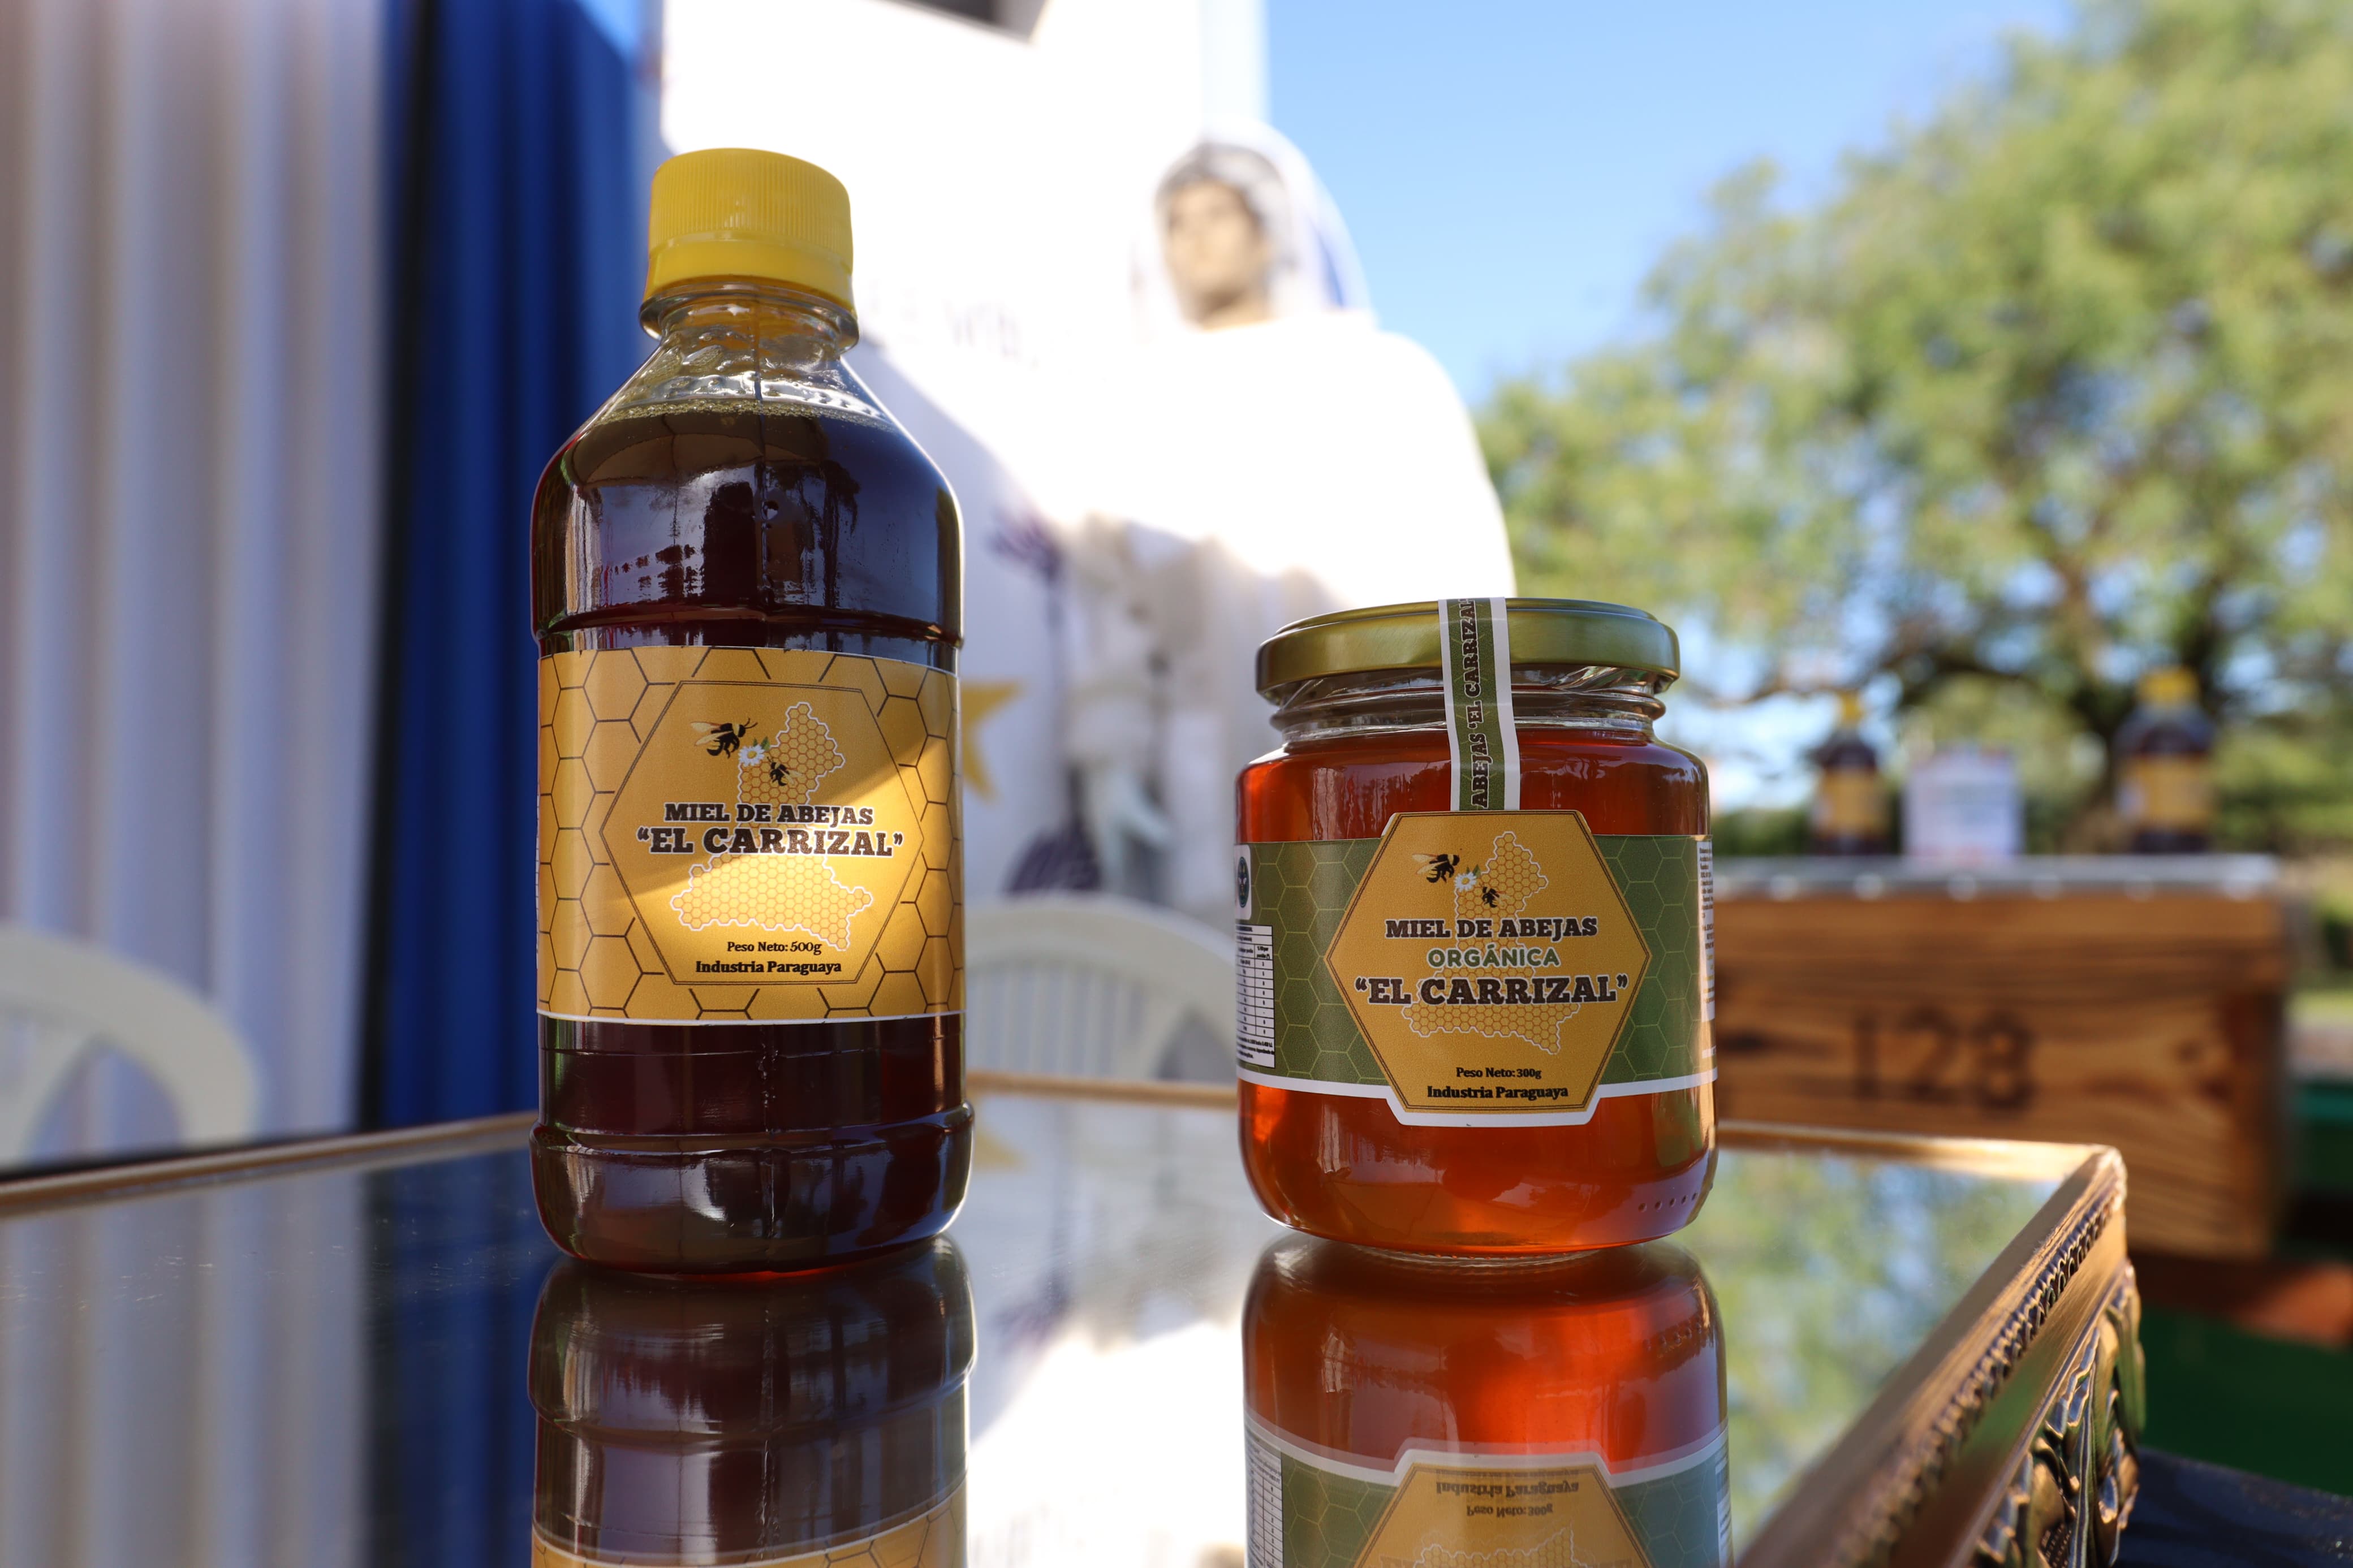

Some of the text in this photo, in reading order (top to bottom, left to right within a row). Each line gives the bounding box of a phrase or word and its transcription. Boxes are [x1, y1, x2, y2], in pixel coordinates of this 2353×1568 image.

[1469, 733, 1492, 808] ABEJAS
[665, 803, 873, 828] MIEL DE ABEJAS
[637, 826, 903, 857] “EL CARRIZAL”
[1386, 917, 1598, 941] MIEL DE ABEJAS
[727, 941, 755, 952] Peso
[790, 942, 822, 955] 500g
[1427, 944, 1561, 968] ORGÁNICA
[696, 961, 842, 975] Industria Paraguaya
[1355, 974, 1628, 1004] “EL CARRIZAL”
[1456, 1067, 1483, 1078] Peso
[1517, 1068, 1541, 1079] 300g
[1427, 1086, 1568, 1100] Industria Paraguaya
